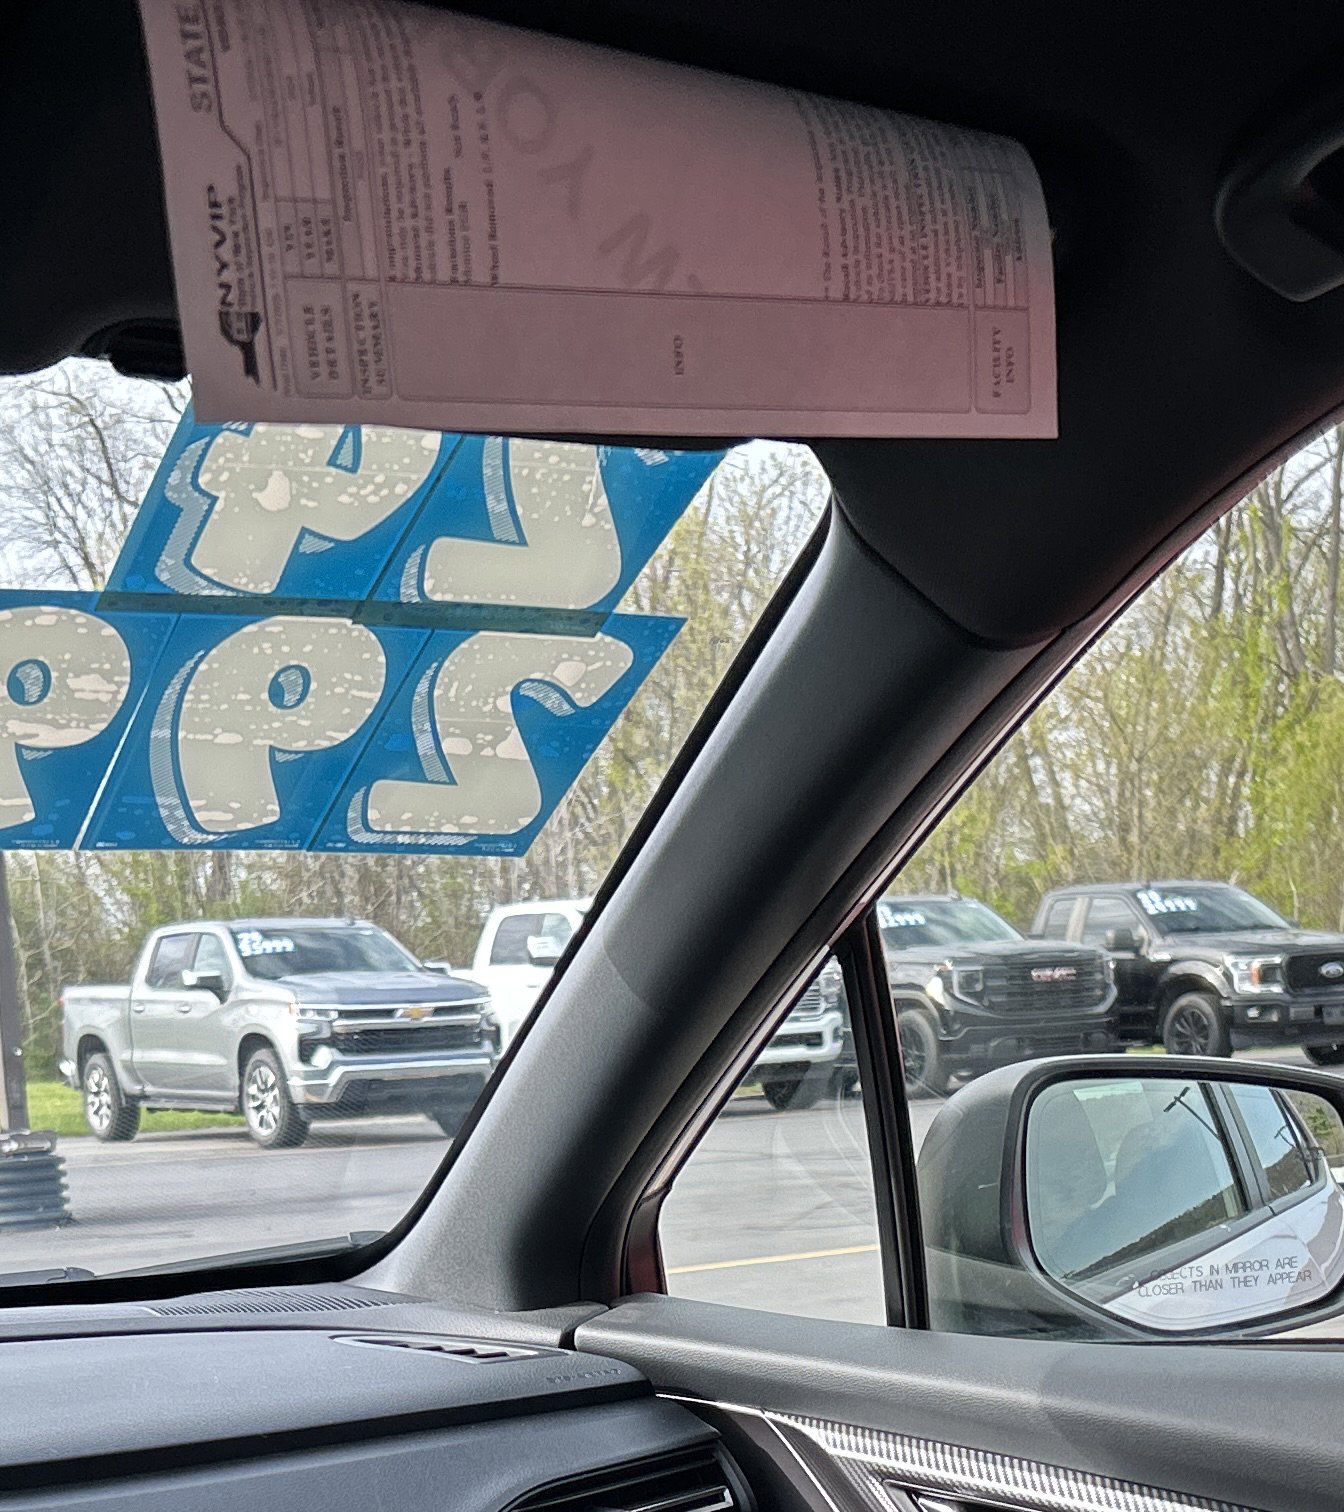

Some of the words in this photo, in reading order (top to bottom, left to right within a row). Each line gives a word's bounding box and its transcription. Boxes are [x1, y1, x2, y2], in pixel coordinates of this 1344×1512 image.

[175, 3, 213, 114] STATE
[206, 184, 234, 308] NYVIP
[1138, 1281, 1185, 1298] CLOSER
[1191, 1278, 1224, 1293] THAN
[1230, 1274, 1260, 1289] THEY
[1267, 1269, 1313, 1286] APPEAR
[1209, 1263, 1221, 1277] IN
[1225, 1258, 1270, 1276] MIRROR
[1274, 1255, 1299, 1270] ARE
